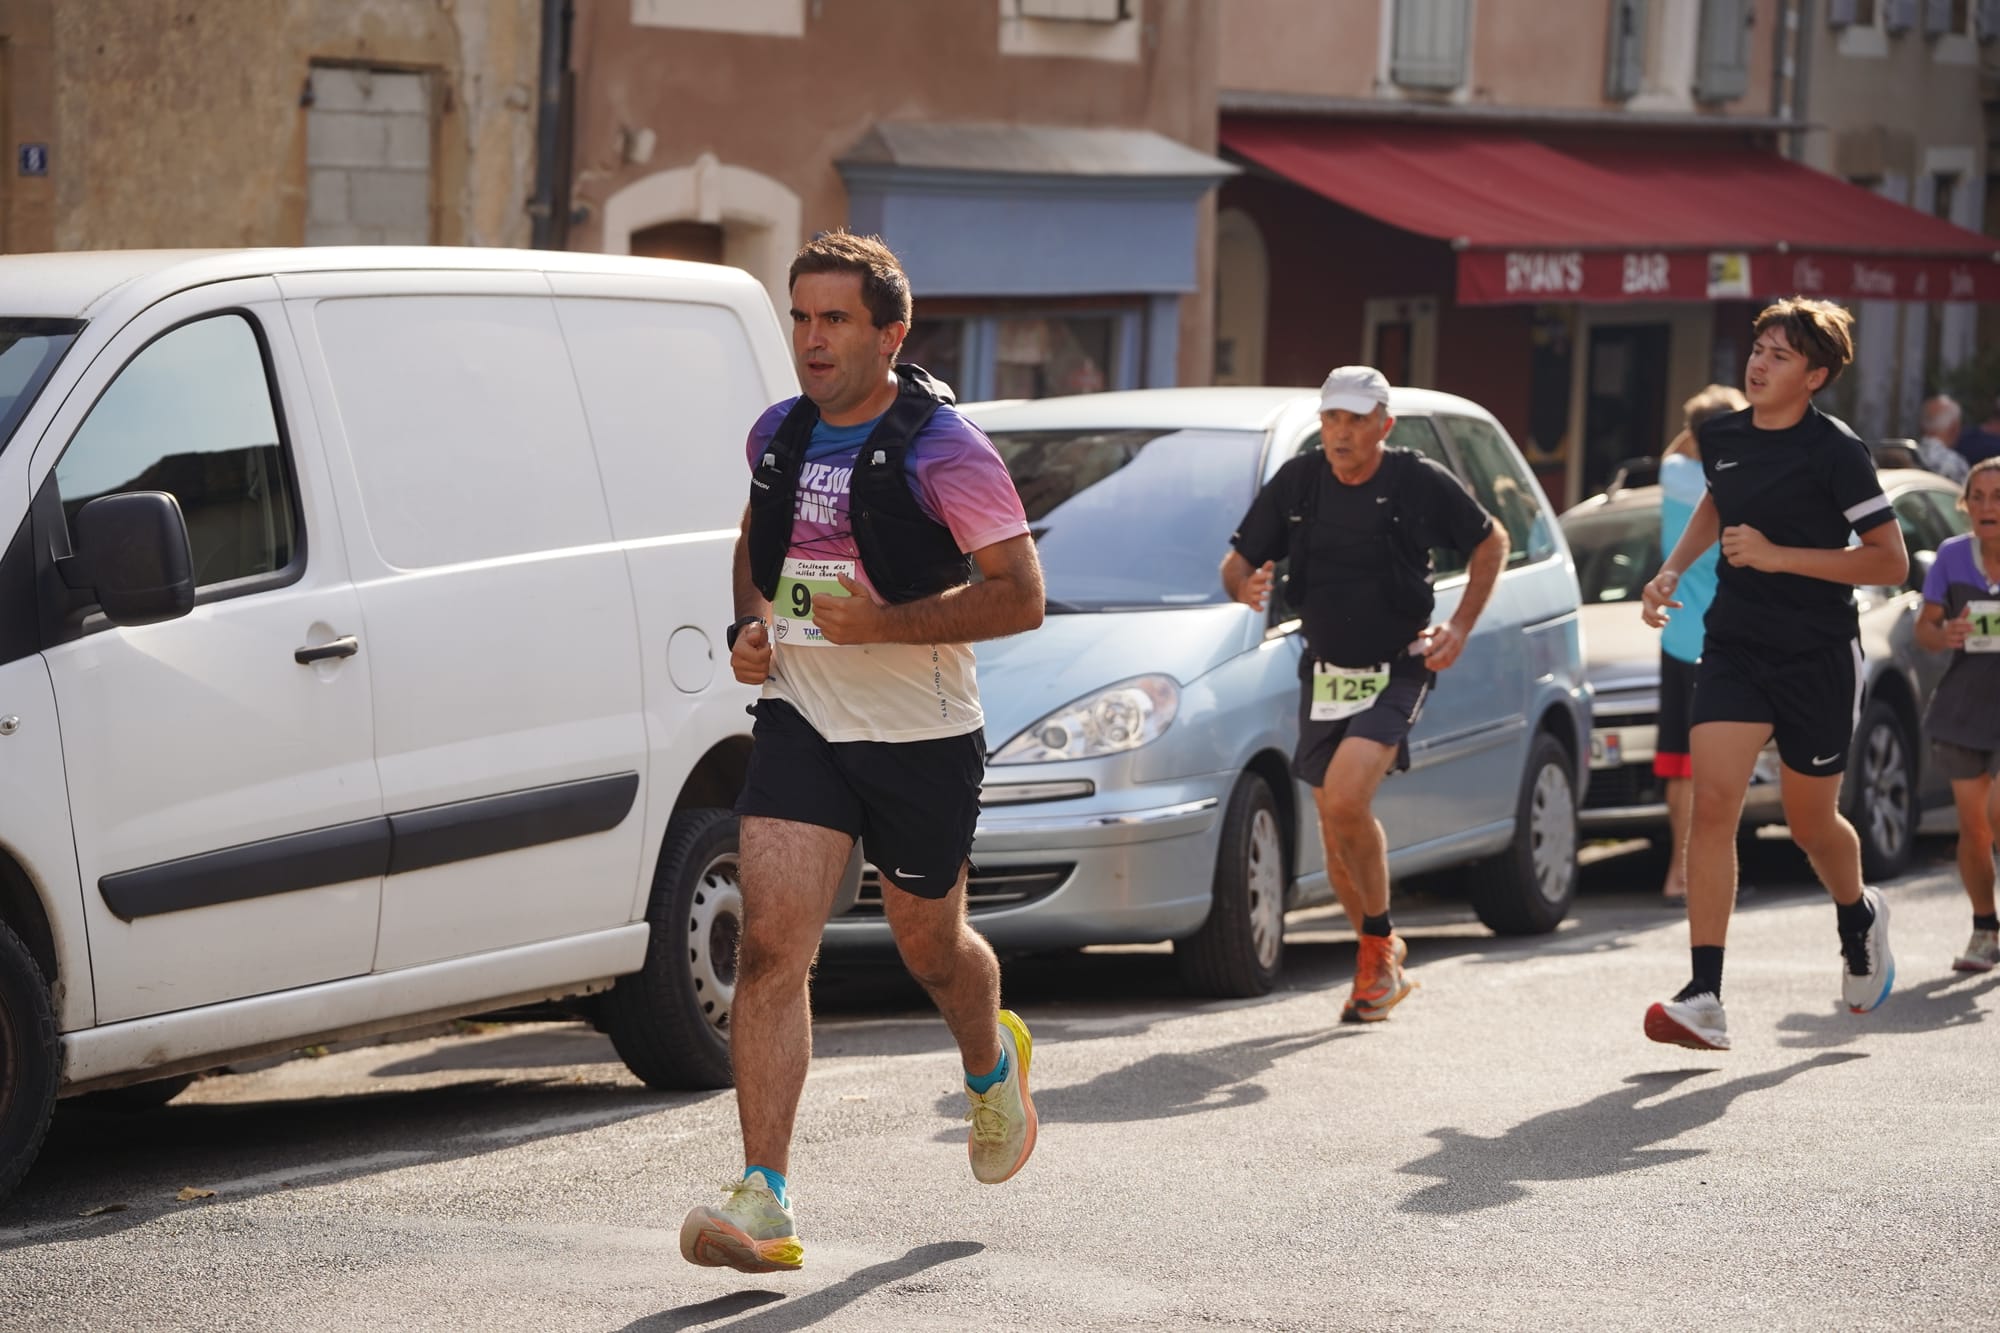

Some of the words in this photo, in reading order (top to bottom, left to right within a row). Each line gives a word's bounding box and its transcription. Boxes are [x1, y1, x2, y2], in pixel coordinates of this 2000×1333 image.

[1506, 252, 1584, 294] RYAN'S
[1622, 253, 1670, 294] BAR
[799, 461, 854, 495] VEJOL
[833, 563, 847, 571] des
[791, 582, 812, 618] 9
[802, 628, 822, 637] TUF
[1326, 677, 1377, 702] 125
